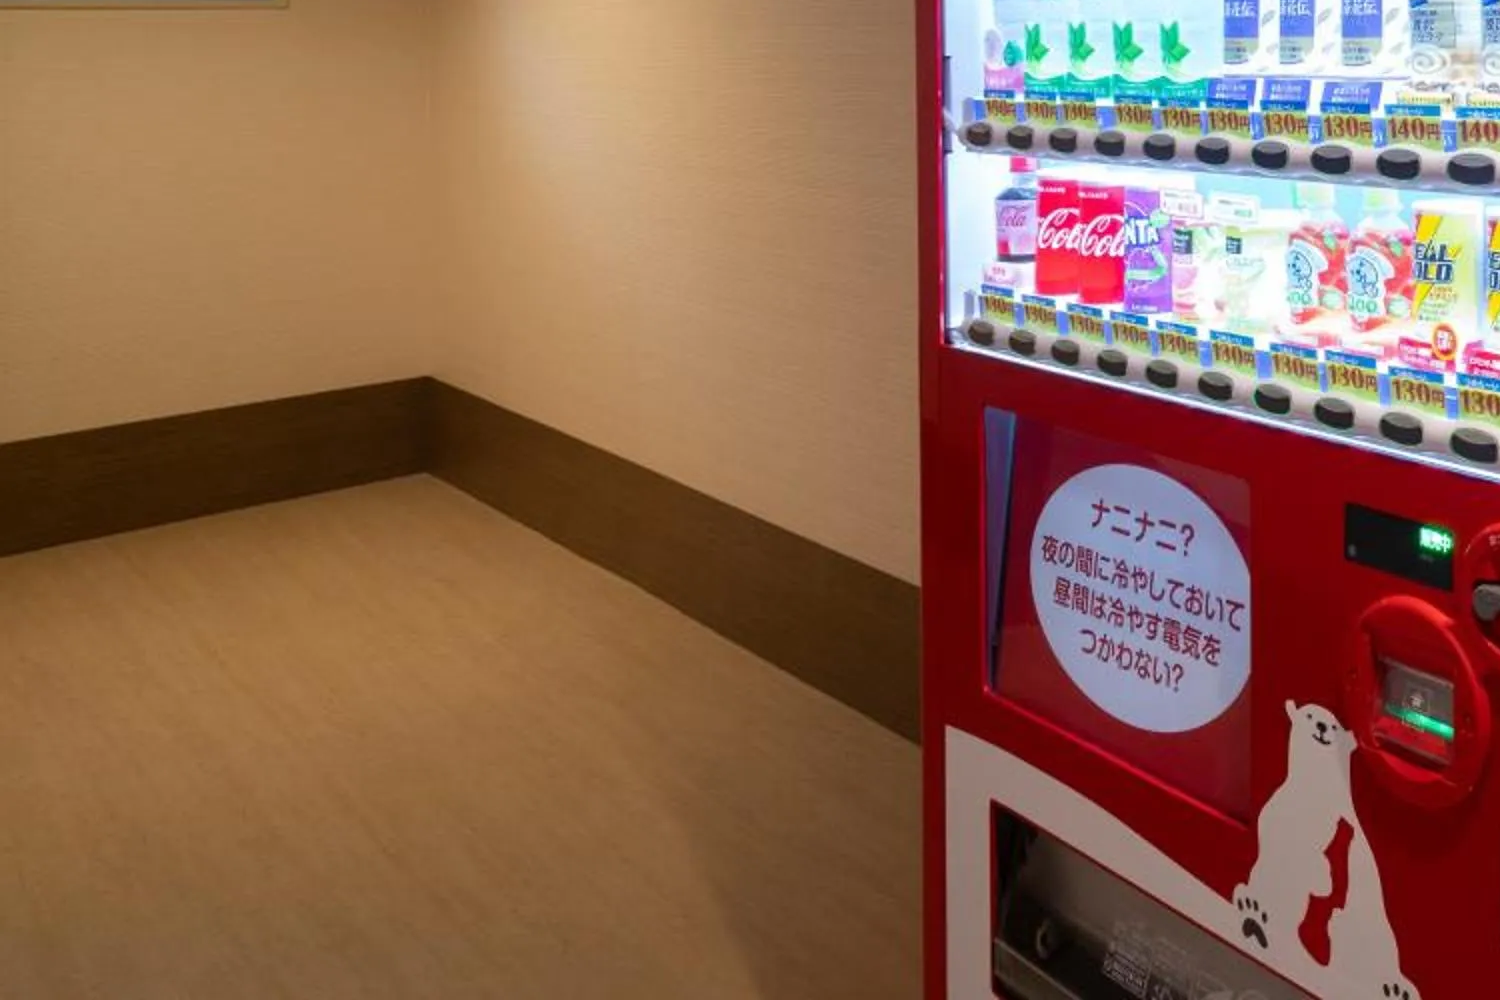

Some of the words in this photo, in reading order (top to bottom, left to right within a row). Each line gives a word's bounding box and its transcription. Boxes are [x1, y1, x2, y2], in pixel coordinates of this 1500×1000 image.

[1264, 113, 1310, 136] 130円
[1324, 116, 1372, 139] 130円
[1388, 118, 1440, 142] 140円
[1273, 354, 1318, 382] 130円
[1330, 364, 1378, 393] 130円
[1393, 376, 1446, 408] 130円
[1090, 498, 1195, 557] ナニナニ?
[1040, 534, 1246, 632] 夜の間に冷やしておいて
[1052, 576, 1222, 667] 昼間は冷やす電気を
[1079, 627, 1185, 693] つかわない?
